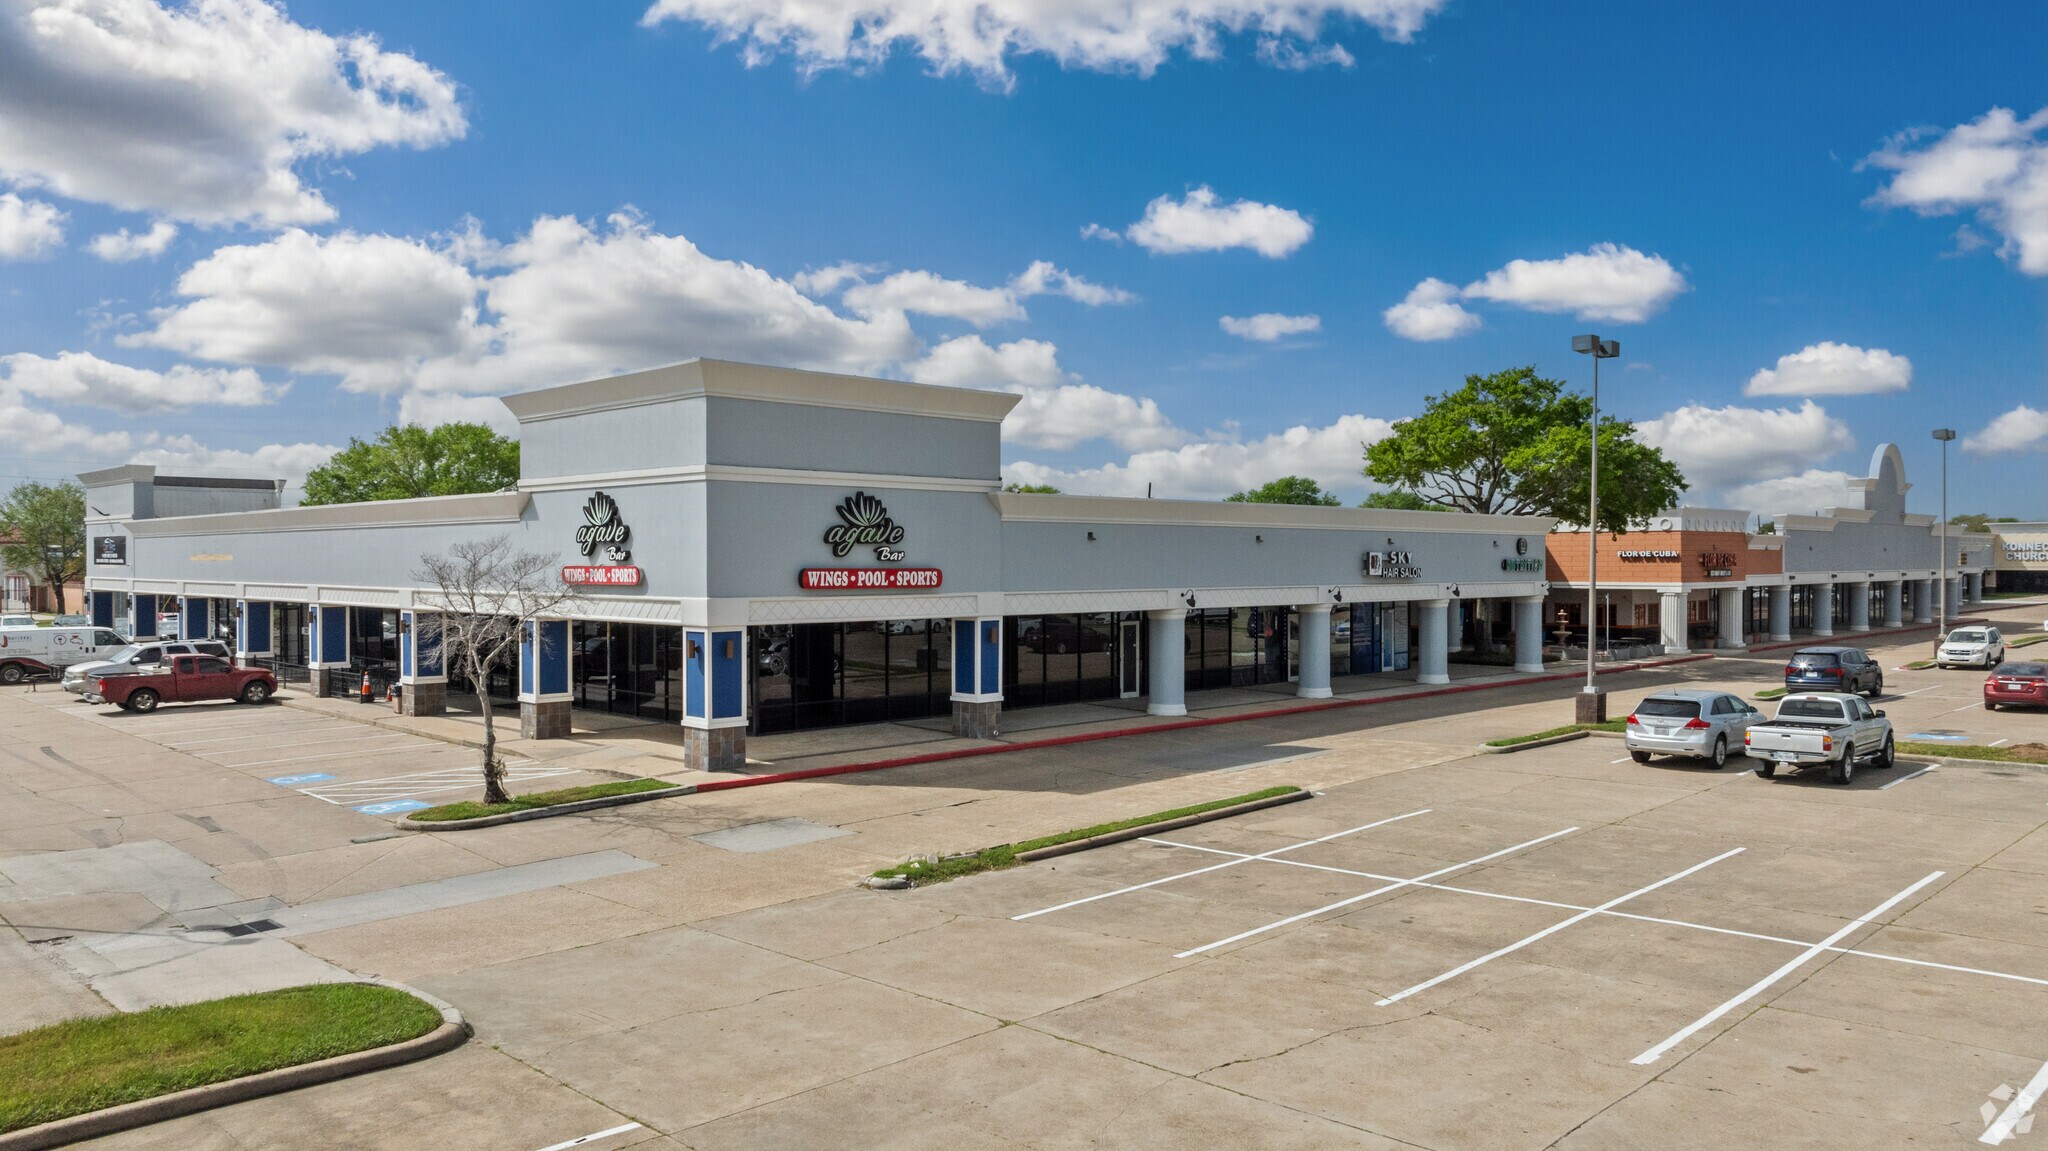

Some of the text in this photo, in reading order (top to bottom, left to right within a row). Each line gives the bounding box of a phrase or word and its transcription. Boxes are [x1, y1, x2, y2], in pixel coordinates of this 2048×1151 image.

[576, 519, 625, 556] agave
[828, 521, 904, 556] agave
[607, 546, 626, 560] Bar
[877, 546, 905, 560] Bar
[1390, 551, 1413, 564] SKY
[2006, 551, 2048, 561] CHURC
[564, 568, 637, 583] WINGS POOL SPORTS
[807, 571, 938, 587] WINGS POOL SPORTS
[1382, 567, 1422, 578] HAIR SALON
